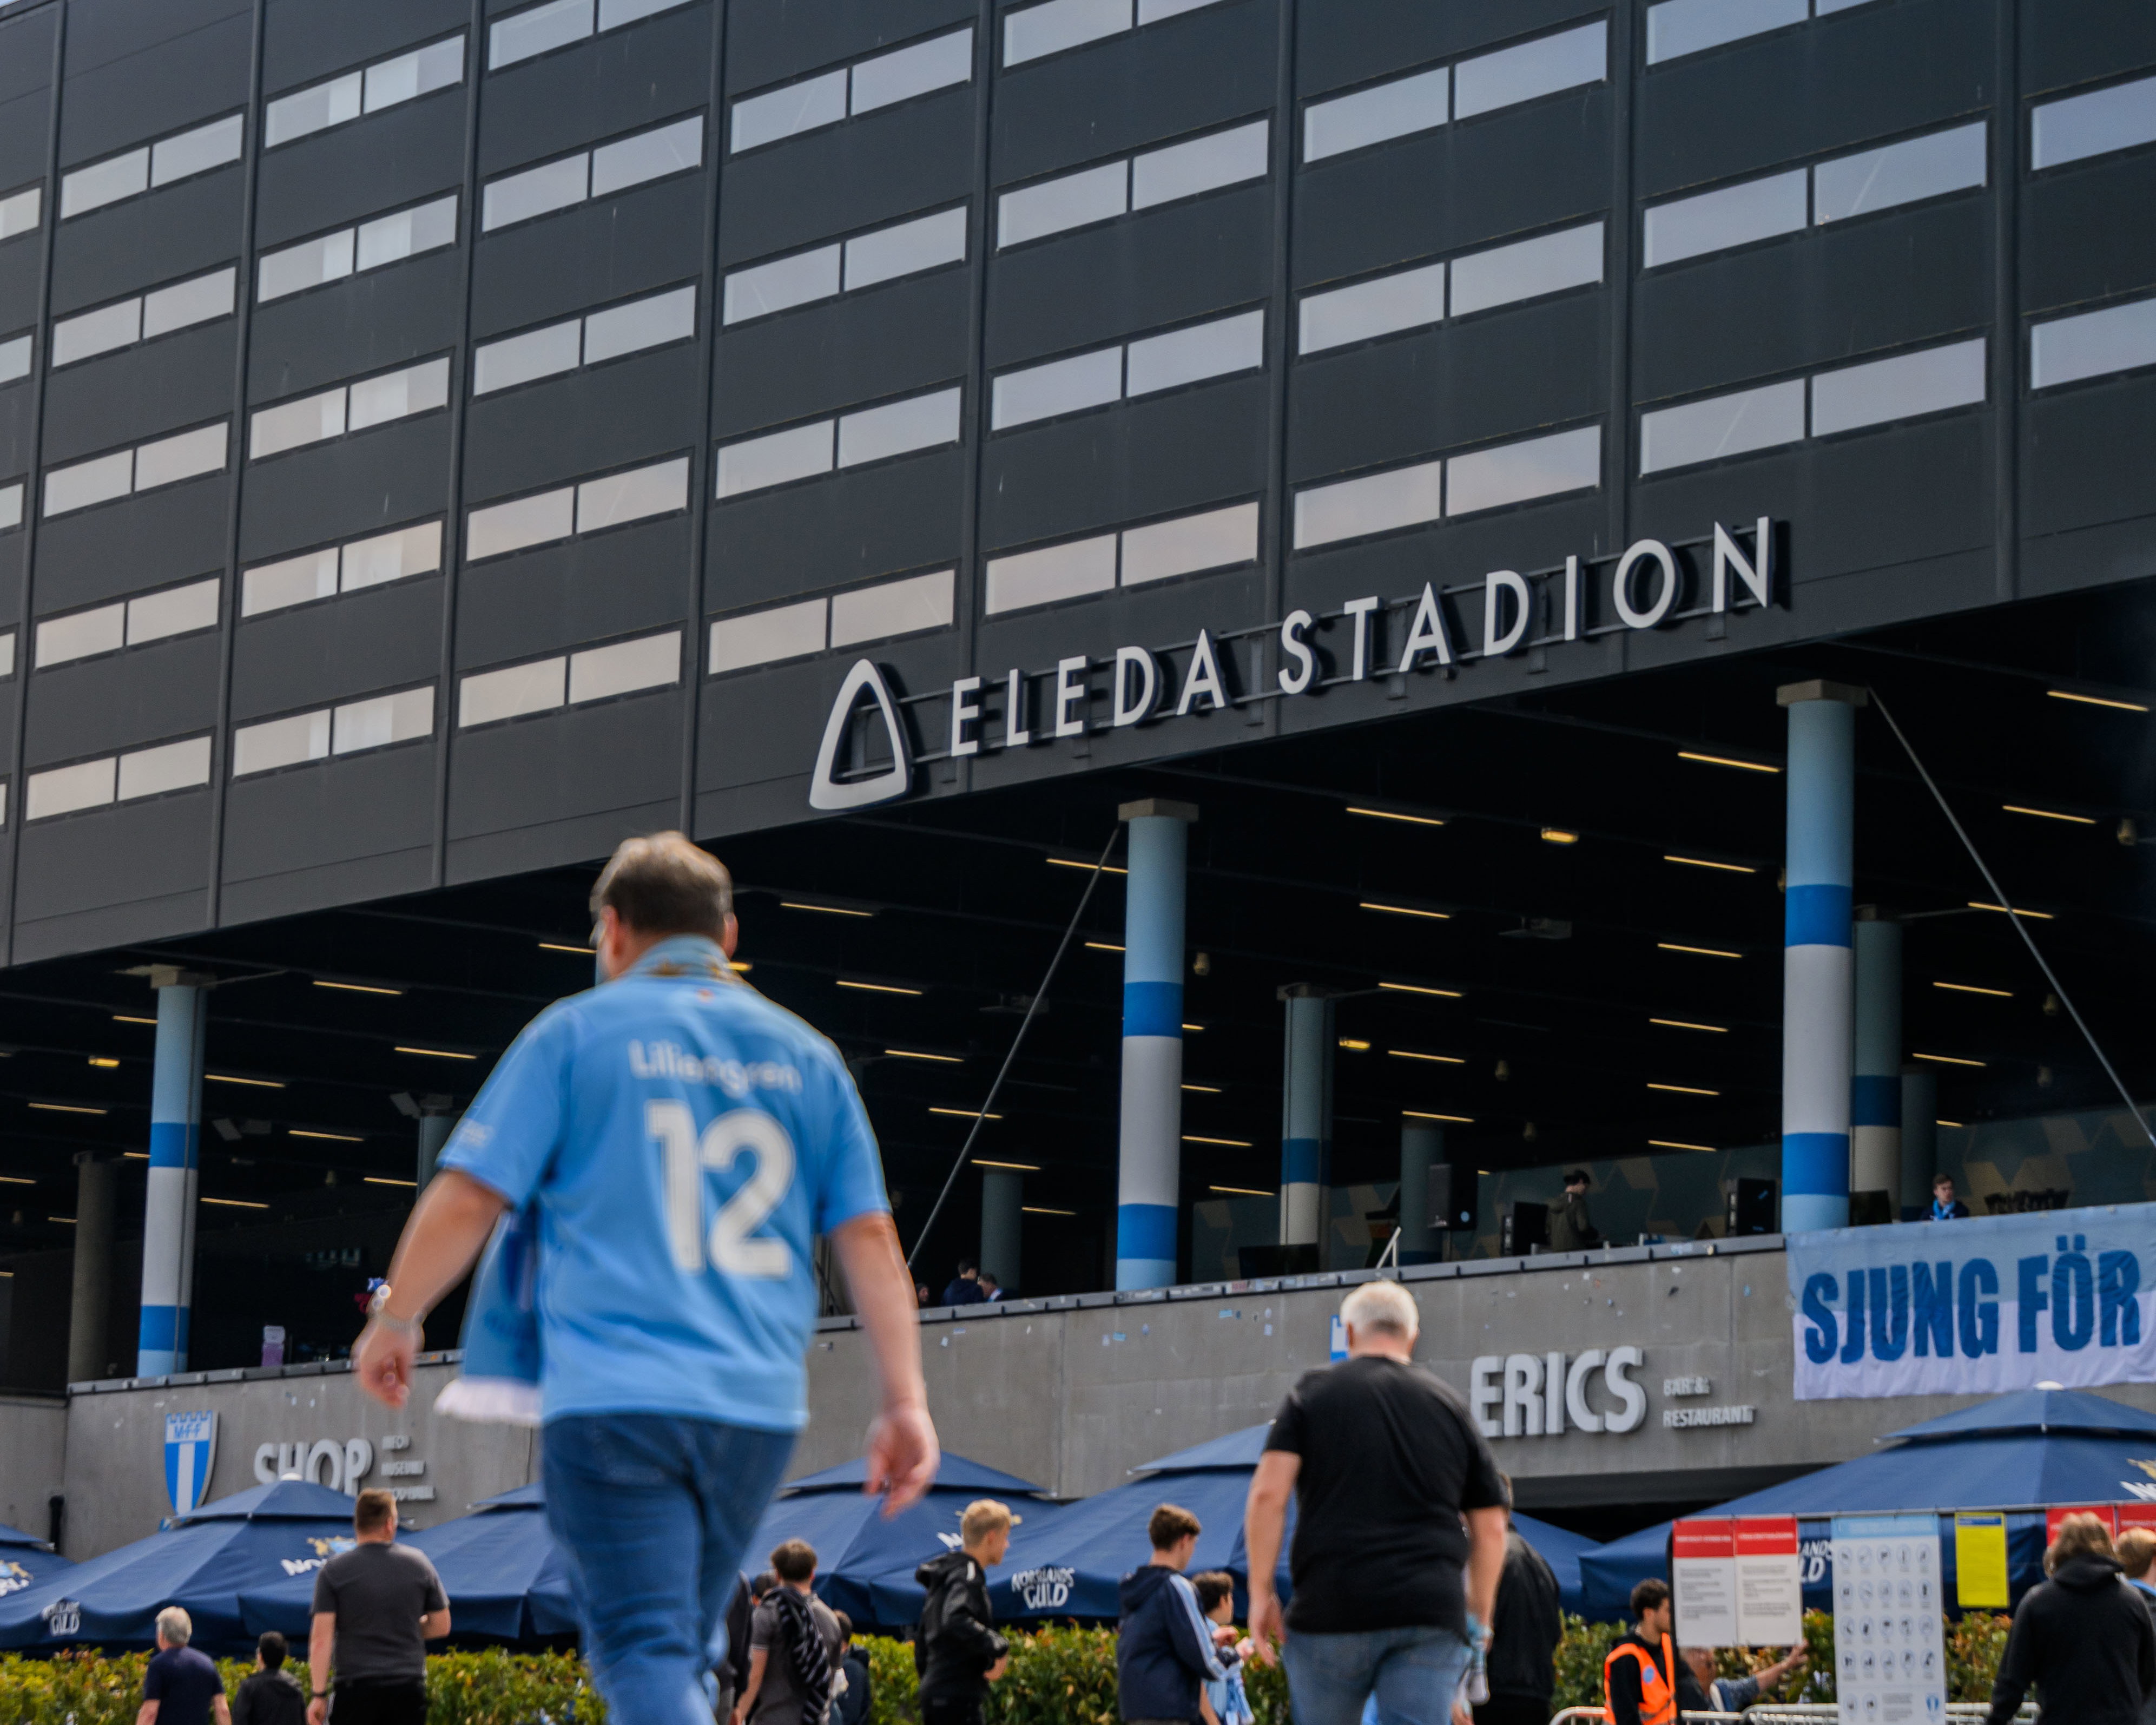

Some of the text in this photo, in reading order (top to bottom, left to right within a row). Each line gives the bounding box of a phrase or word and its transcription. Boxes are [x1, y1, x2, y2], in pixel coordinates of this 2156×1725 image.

[951, 516, 1773, 757] ELEDA STADION
[644, 1098, 796, 1280] 12
[1802, 1233, 2140, 1364] SJUNG FÖR
[1469, 1345, 1647, 1438] ERICS
[1663, 1405, 1755, 1427] RESTAURANT
[253, 1438, 373, 1499] SHOP
[1023, 1582, 1069, 1610] GULD
